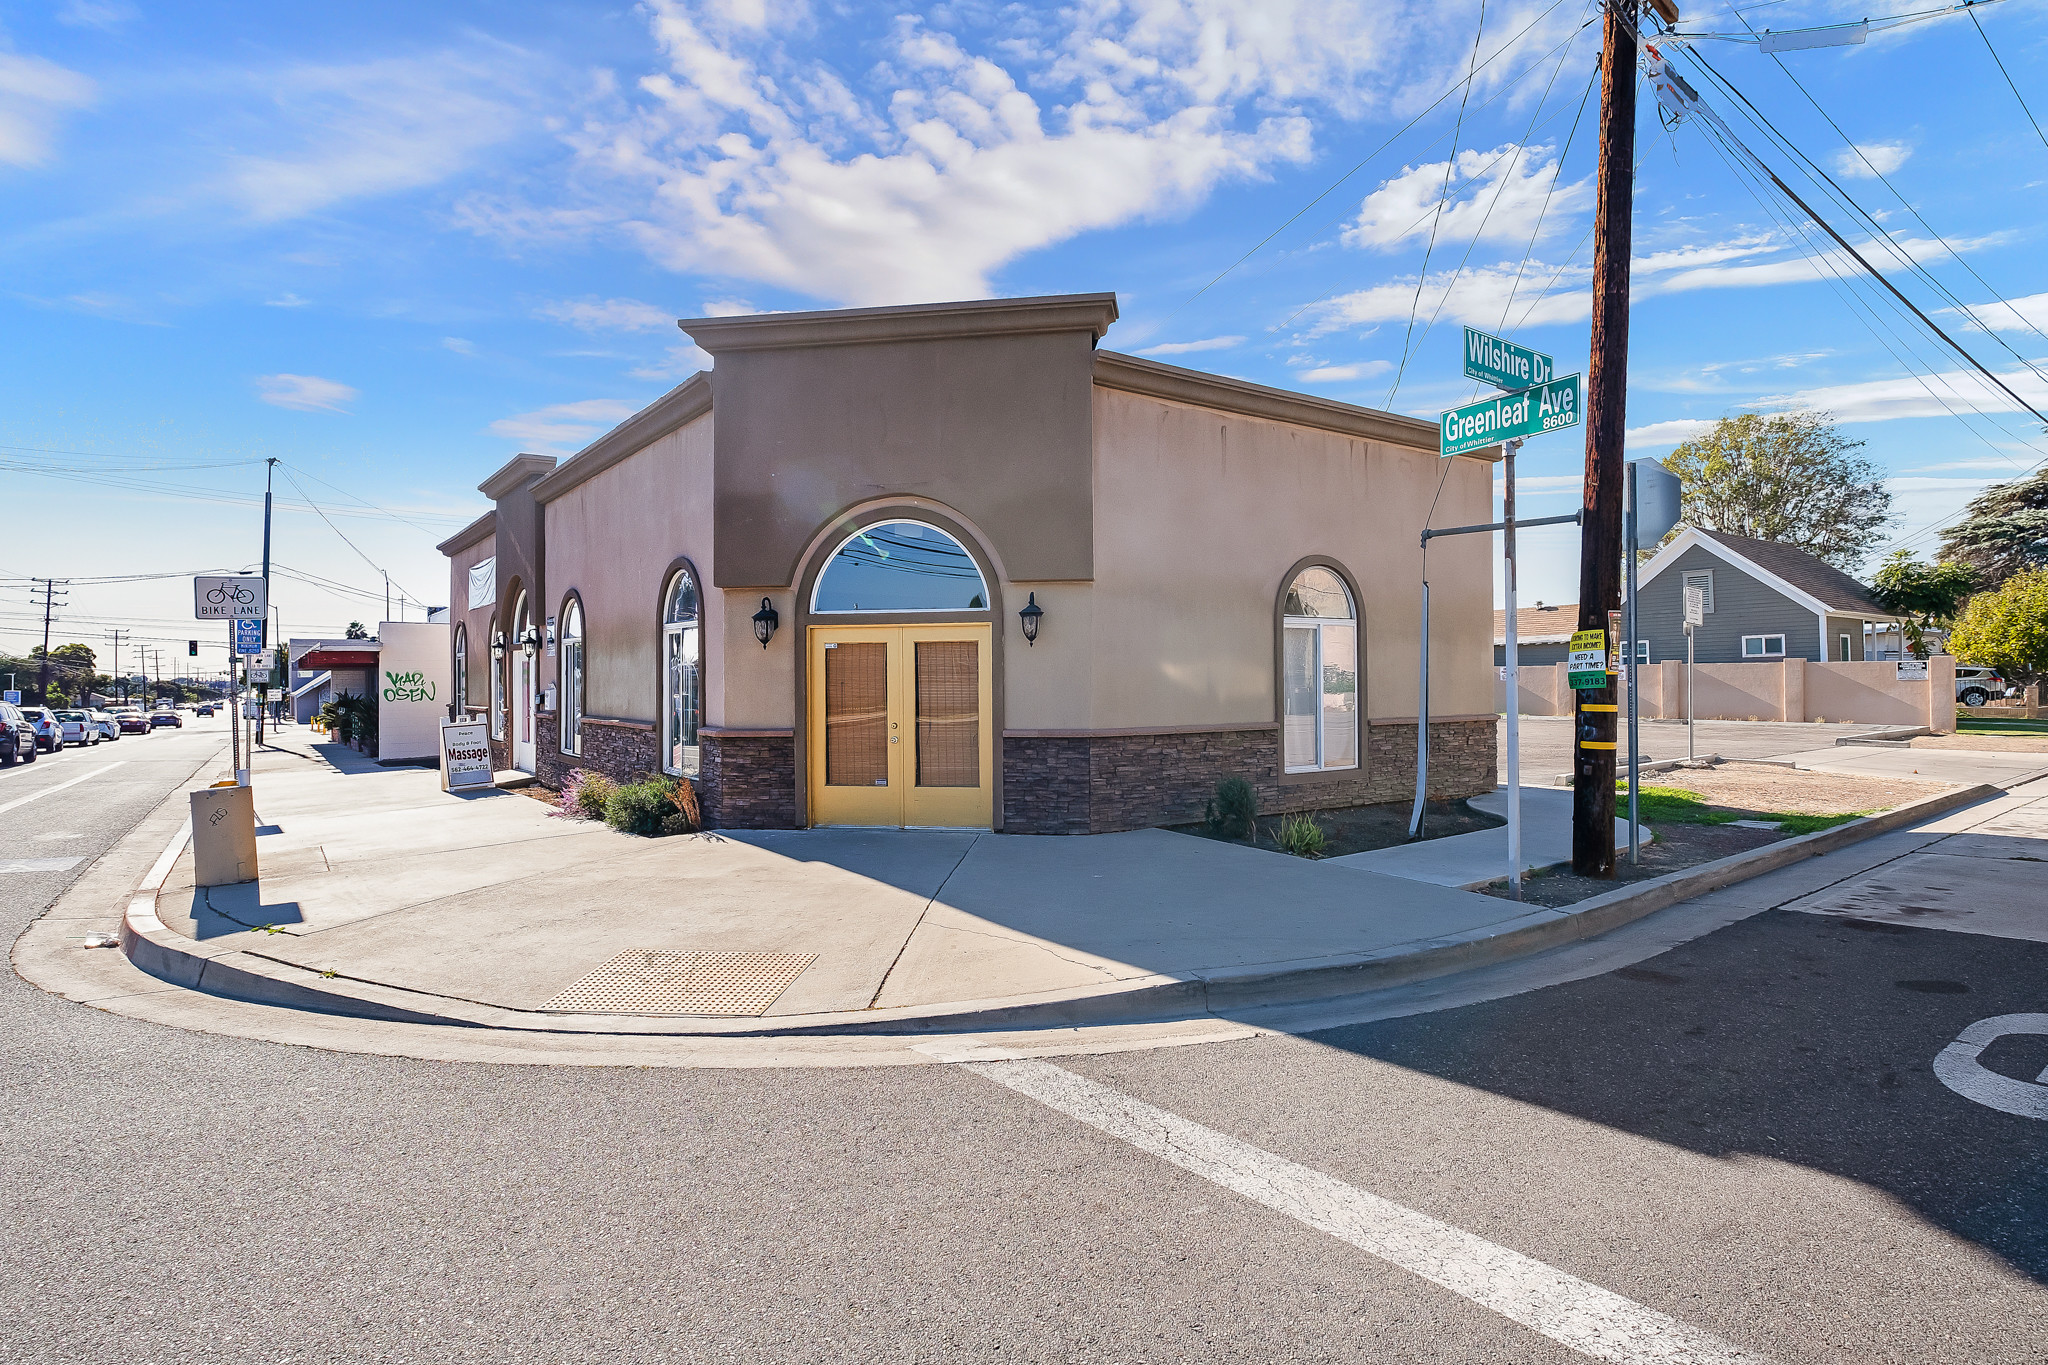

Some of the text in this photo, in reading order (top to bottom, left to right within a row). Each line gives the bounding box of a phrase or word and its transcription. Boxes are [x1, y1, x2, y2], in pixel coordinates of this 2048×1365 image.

[1467, 330, 1551, 384] Wilshire Dr
[1467, 367, 1478, 377] City
[1484, 372, 1503, 384] Whittier
[1445, 385, 1574, 442] Greenleaf Ave
[1542, 411, 1573, 430] 8600
[1445, 445, 1458, 453] City
[1466, 436, 1495, 448] Whittier
[201, 606, 261, 615] BIKE LANE
[1589, 632, 1603, 640] MAKE
[1574, 653, 1588, 661] NEED
[447, 747, 488, 762] Massage
